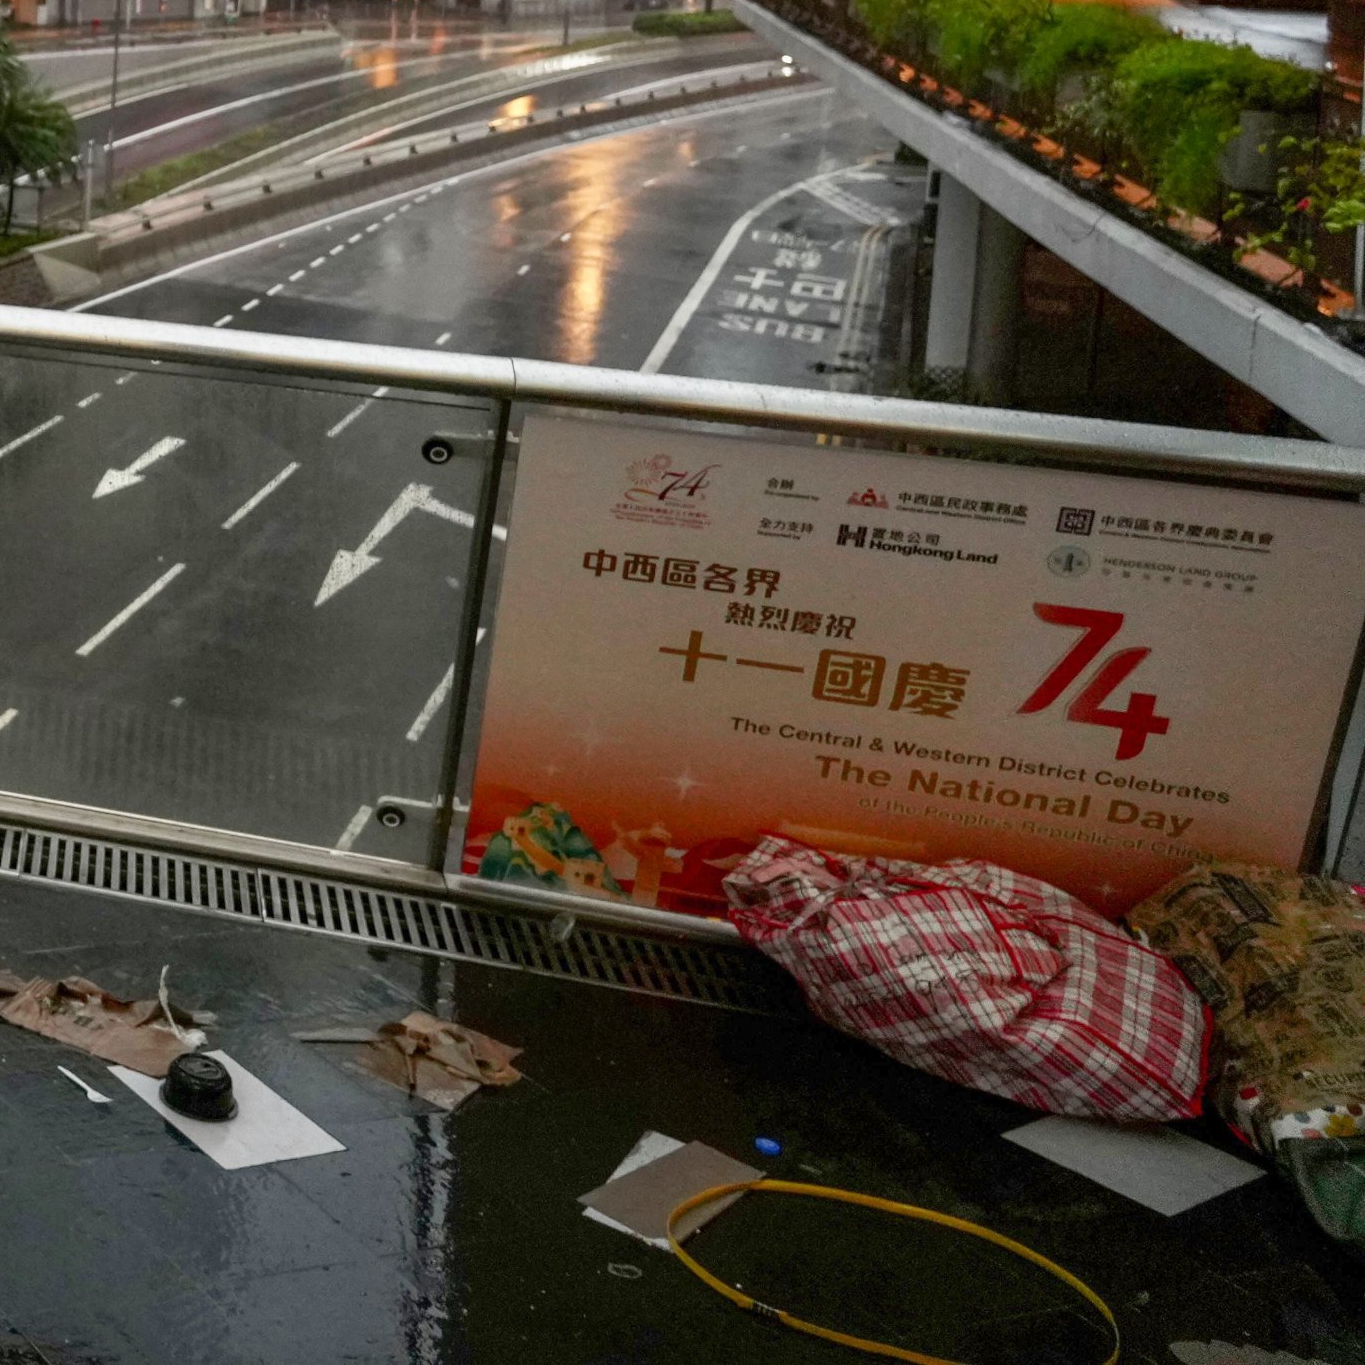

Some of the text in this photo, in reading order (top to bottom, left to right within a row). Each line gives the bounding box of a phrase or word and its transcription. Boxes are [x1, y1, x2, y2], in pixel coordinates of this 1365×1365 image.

[660, 464, 721, 501] 74
[899, 491, 1029, 518] 中西區民政事務處
[760, 517, 814, 534] 全力支持
[1101, 515, 1273, 546] 中西區各界慶典委員會
[869, 540, 998, 564] Hongkong Land
[1104, 557, 1175, 573] HENDERSON
[1179, 566, 1211, 578] LAND
[1215, 570, 1258, 583] GROUP
[582, 548, 781, 599] 中西區各界
[725, 601, 858, 641] 熱烈慶祝
[658, 629, 971, 719] 十一國慶
[1015, 601, 1171, 761] 74
[731, 717, 1230, 804] The Central & Western District Celebrates
[815, 754, 1194, 838] The National Day
[858, 796, 880, 809] of
[885, 798, 914, 816] the
[1121, 836, 1145, 850] of
